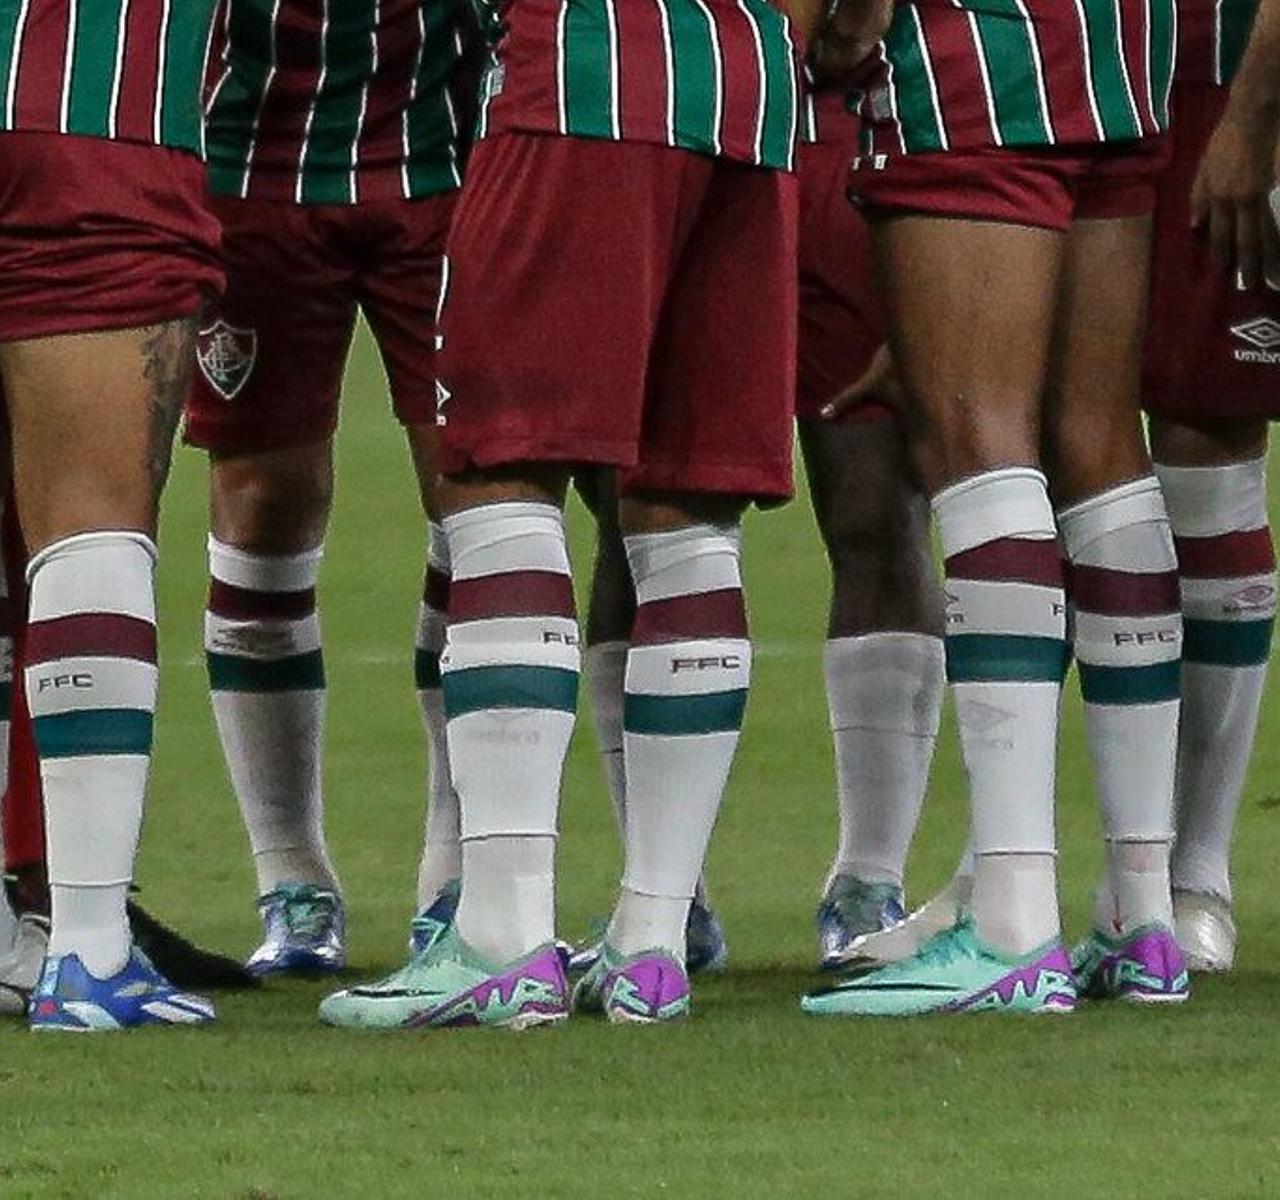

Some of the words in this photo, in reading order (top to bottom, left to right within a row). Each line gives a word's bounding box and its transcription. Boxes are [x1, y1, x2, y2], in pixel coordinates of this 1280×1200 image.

[1113, 631, 1178, 646] FFC
[671, 655, 740, 673] FFC
[39, 674, 94, 693] FFC
